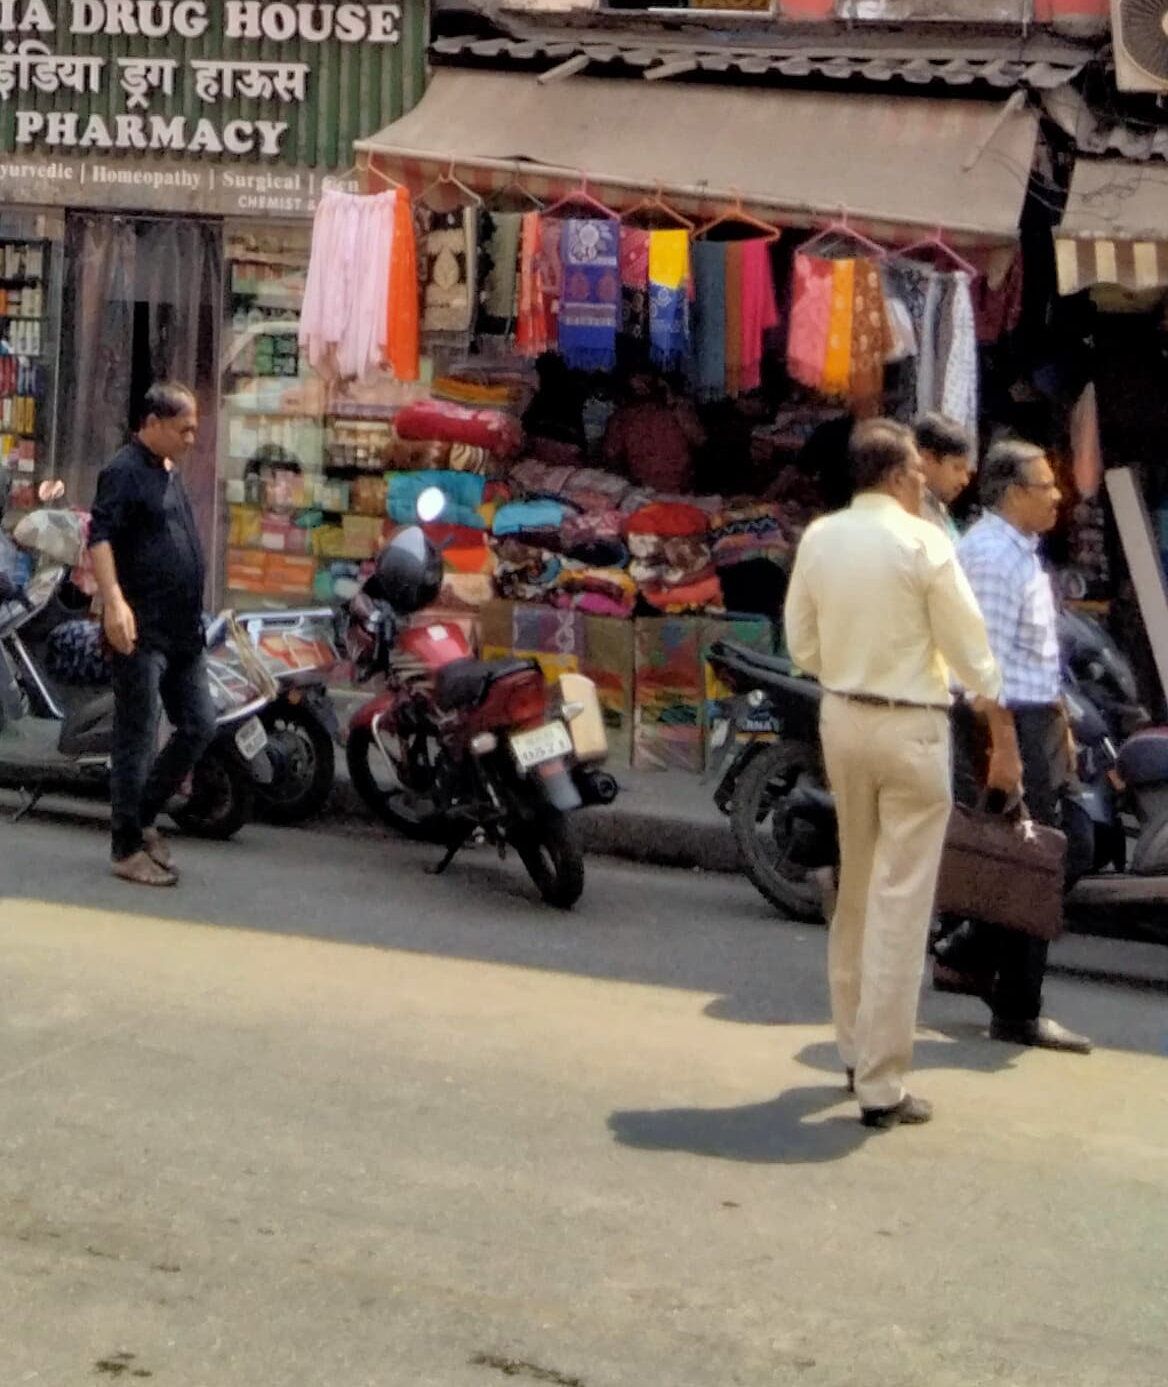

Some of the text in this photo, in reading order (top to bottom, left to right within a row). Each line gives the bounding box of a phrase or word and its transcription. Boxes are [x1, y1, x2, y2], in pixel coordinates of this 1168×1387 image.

[224, 0, 403, 43] HOUSE
[190, 60, 312, 103] हाऊस
[15, 111, 288, 155] PHARMACY
[92, 165, 203, 190] Homeopathy
[222, 170, 301, 192] Surgical
[238, 195, 302, 211] CHEMIST
